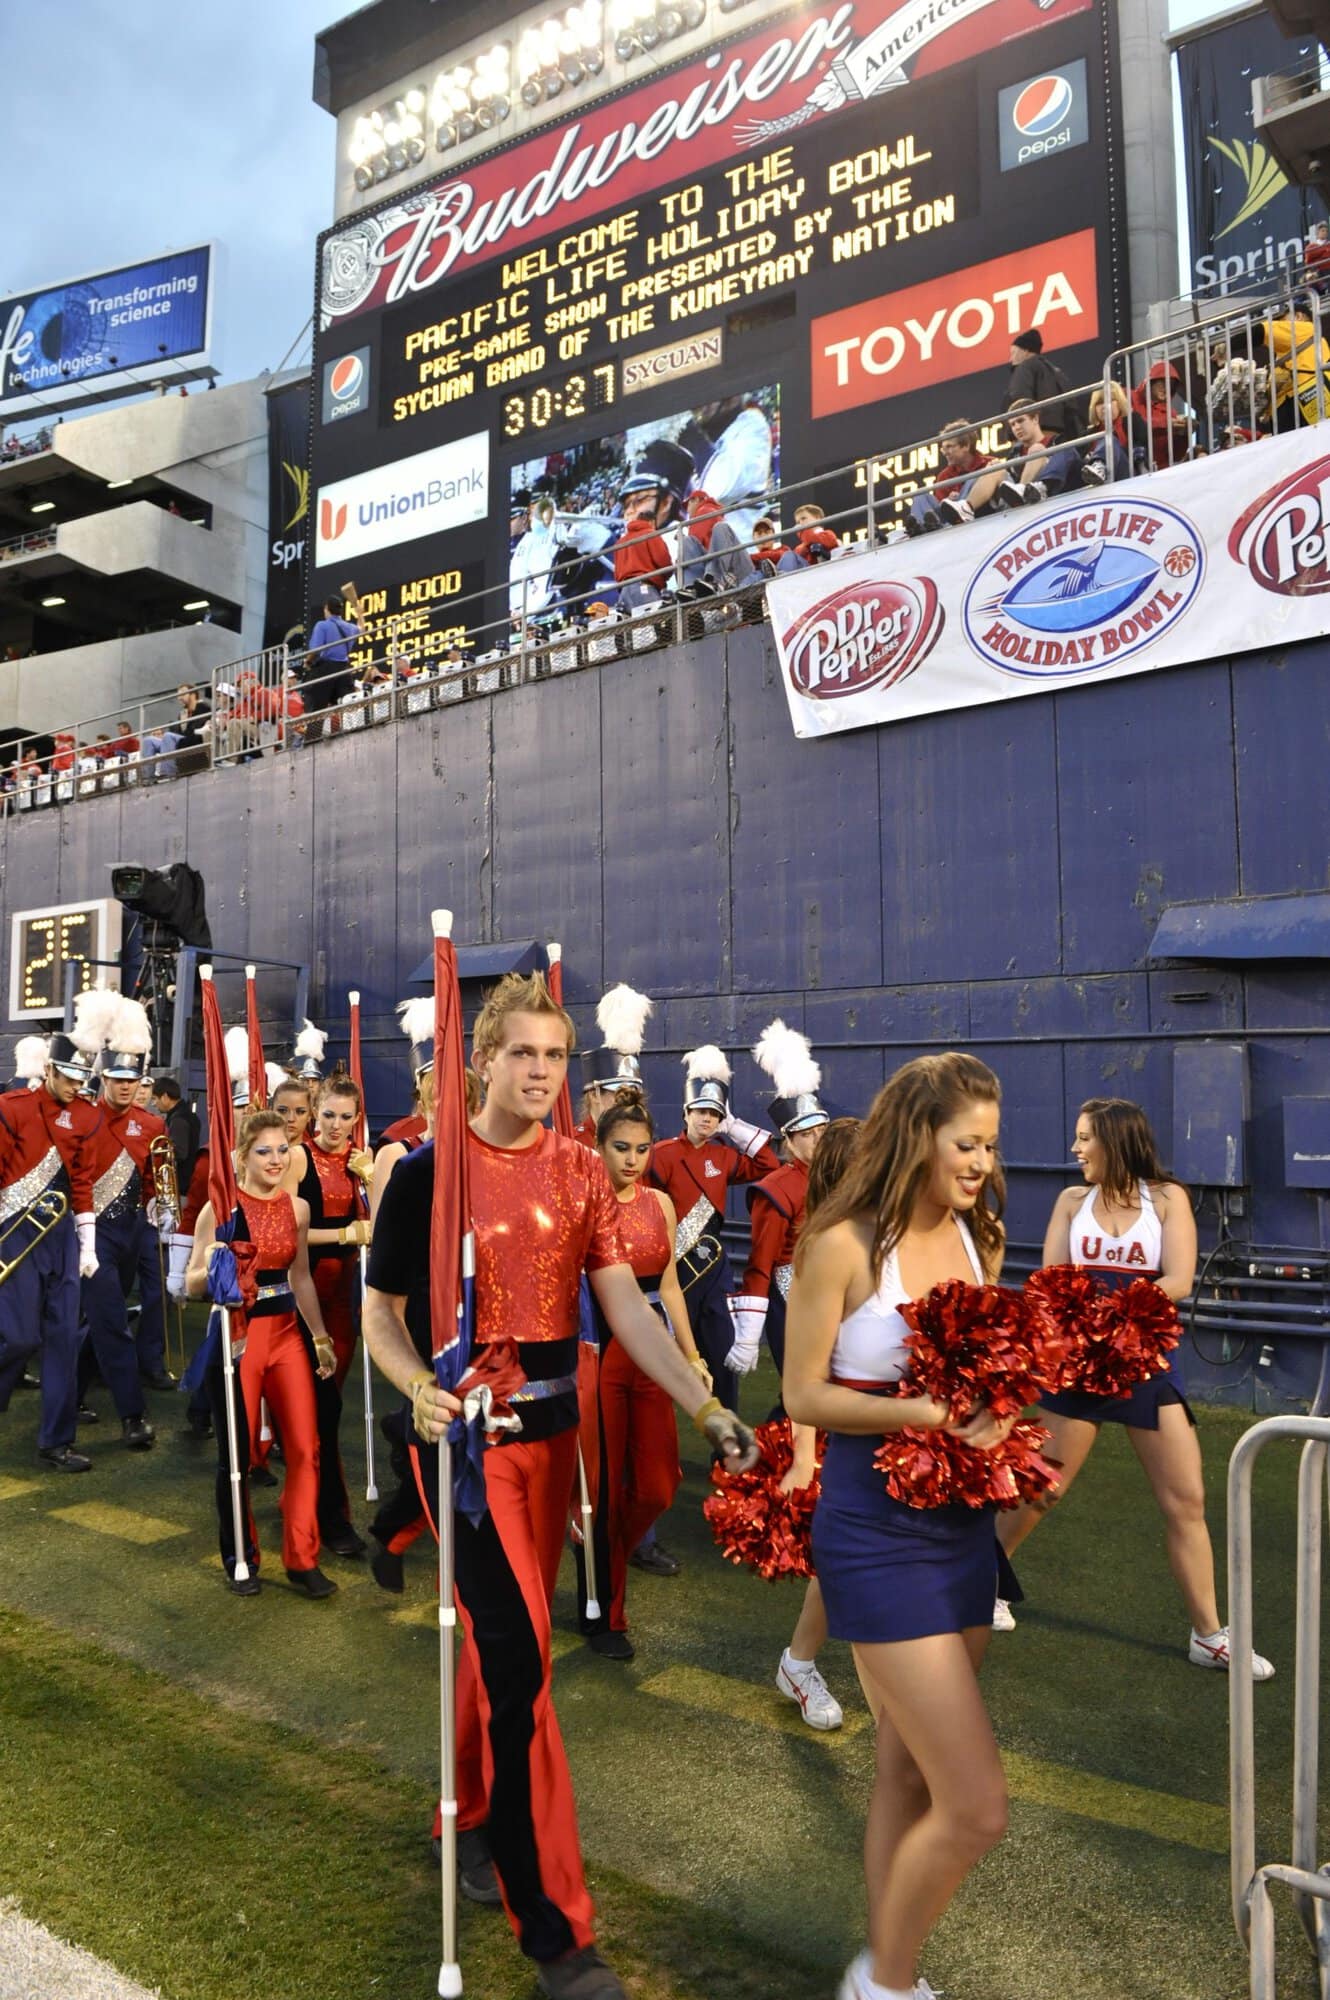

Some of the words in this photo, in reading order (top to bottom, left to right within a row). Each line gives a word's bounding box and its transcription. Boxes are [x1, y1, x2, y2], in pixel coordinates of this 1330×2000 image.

[370, 2, 854, 303] Budweiser
[1018, 127, 1071, 164] pepsi
[405, 289, 530, 360] PACIFIC
[547, 249, 627, 304] LIFE
[647, 178, 805, 265] HOLIDAY
[828, 135, 932, 195] BOWL
[502, 210, 639, 289] WELCOME
[659, 184, 703, 223] TO
[725, 146, 794, 197] THE
[88, 275, 198, 315] Transforming
[110, 300, 171, 327] science
[393, 371, 474, 421] SYCUAN
[486, 345, 545, 387] BAND
[559, 328, 590, 361] OF
[606, 304, 655, 343] THE
[670, 245, 814, 321] KUMEYAAY
[832, 194, 955, 262] NATION
[419, 322, 531, 383] PRE-GAME
[544, 293, 607, 334] SHOW
[621, 230, 776, 307] PRESENTED
[794, 206, 832, 242] BY
[852, 177, 912, 219] THE
[0, 305, 34, 396] fe
[624, 335, 720, 386] SYCUAN
[824, 271, 1083, 387] TOYOTA
[8, 351, 103, 386] technologies
[504, 363, 615, 436] 30:27
[331, 395, 360, 419] pepsi
[993, 513, 1097, 582] PACIFIC
[1098, 508, 1163, 545] LIFE
[1255, 494, 1330, 583] Pe
[401, 570, 462, 606] WOOD
[836, 598, 880, 643] Dr
[348, 648, 373, 673] GH
[358, 606, 431, 645] RIDGE
[794, 605, 910, 689] Pepper
[982, 621, 1097, 666] HOLIDAY
[1099, 589, 1183, 655] BOWL
[24, 914, 91, 1007] 25
[1081, 1236, 1103, 1260] U
[1105, 1246, 1123, 1262] of
[1125, 1241, 1148, 1265] A
